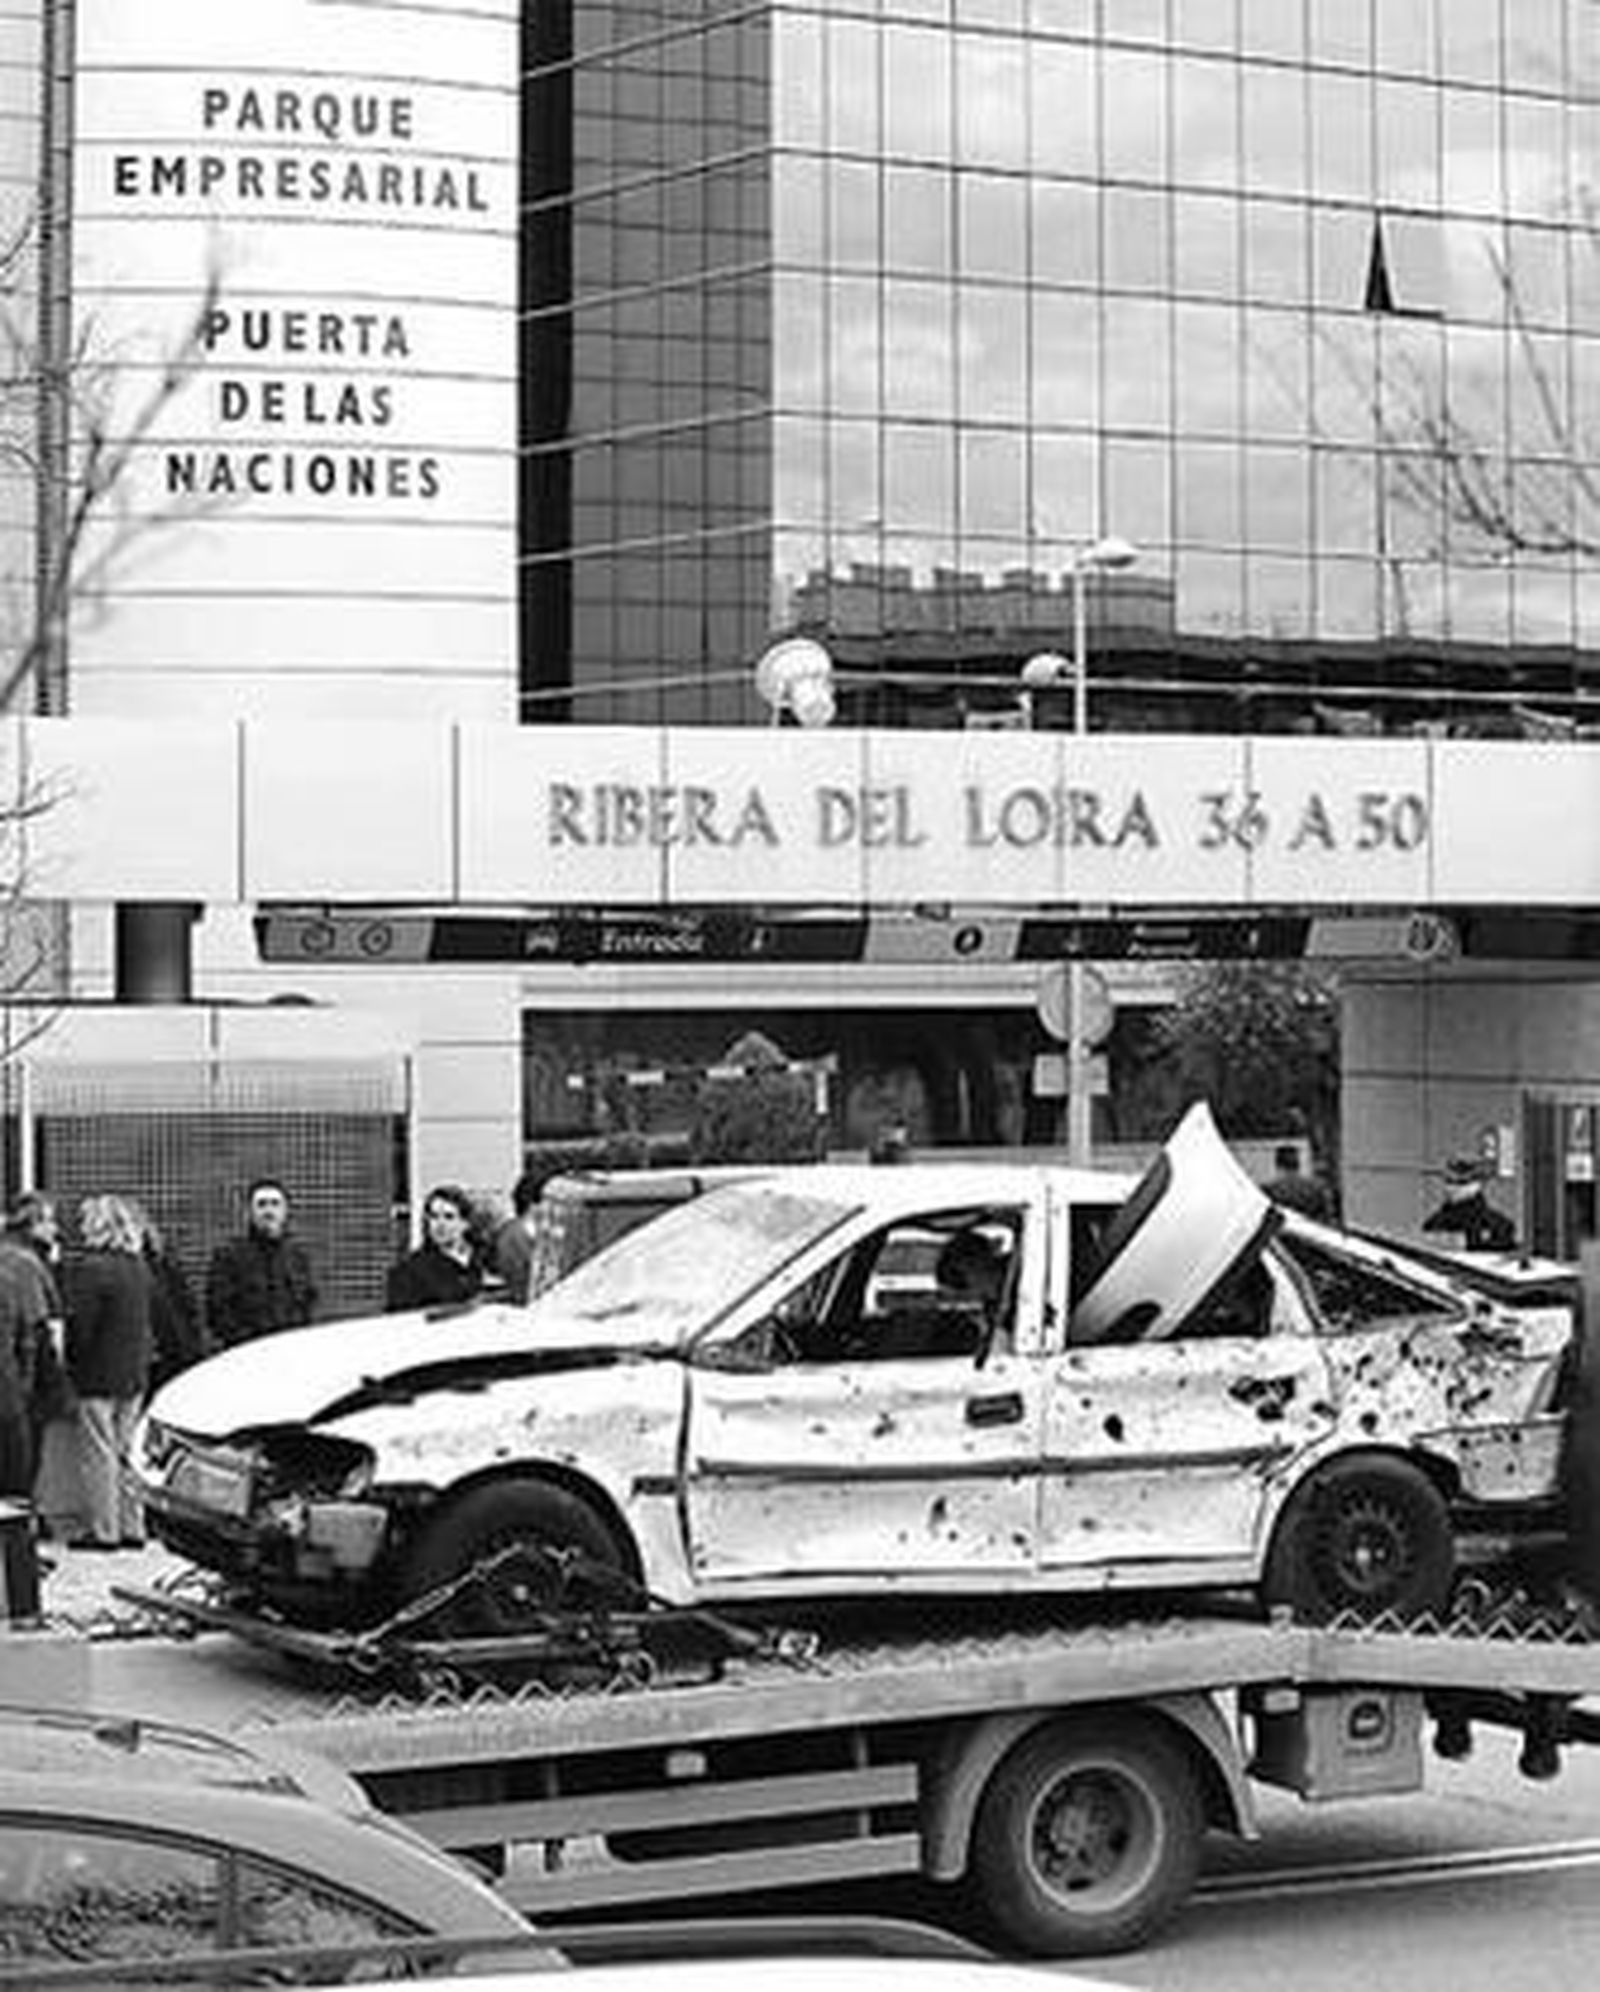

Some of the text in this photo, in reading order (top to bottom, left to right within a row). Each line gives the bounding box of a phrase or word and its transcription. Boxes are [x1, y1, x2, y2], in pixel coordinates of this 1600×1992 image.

[204, 88, 413, 139] PARQUE
[114, 155, 489, 212] EMPRESARIAL
[205, 310, 411, 357] PUERTA
[166, 452, 441, 500] NACIONES
[548, 783, 1428, 853] RIBERA DEL LOIRA 36 A 50
